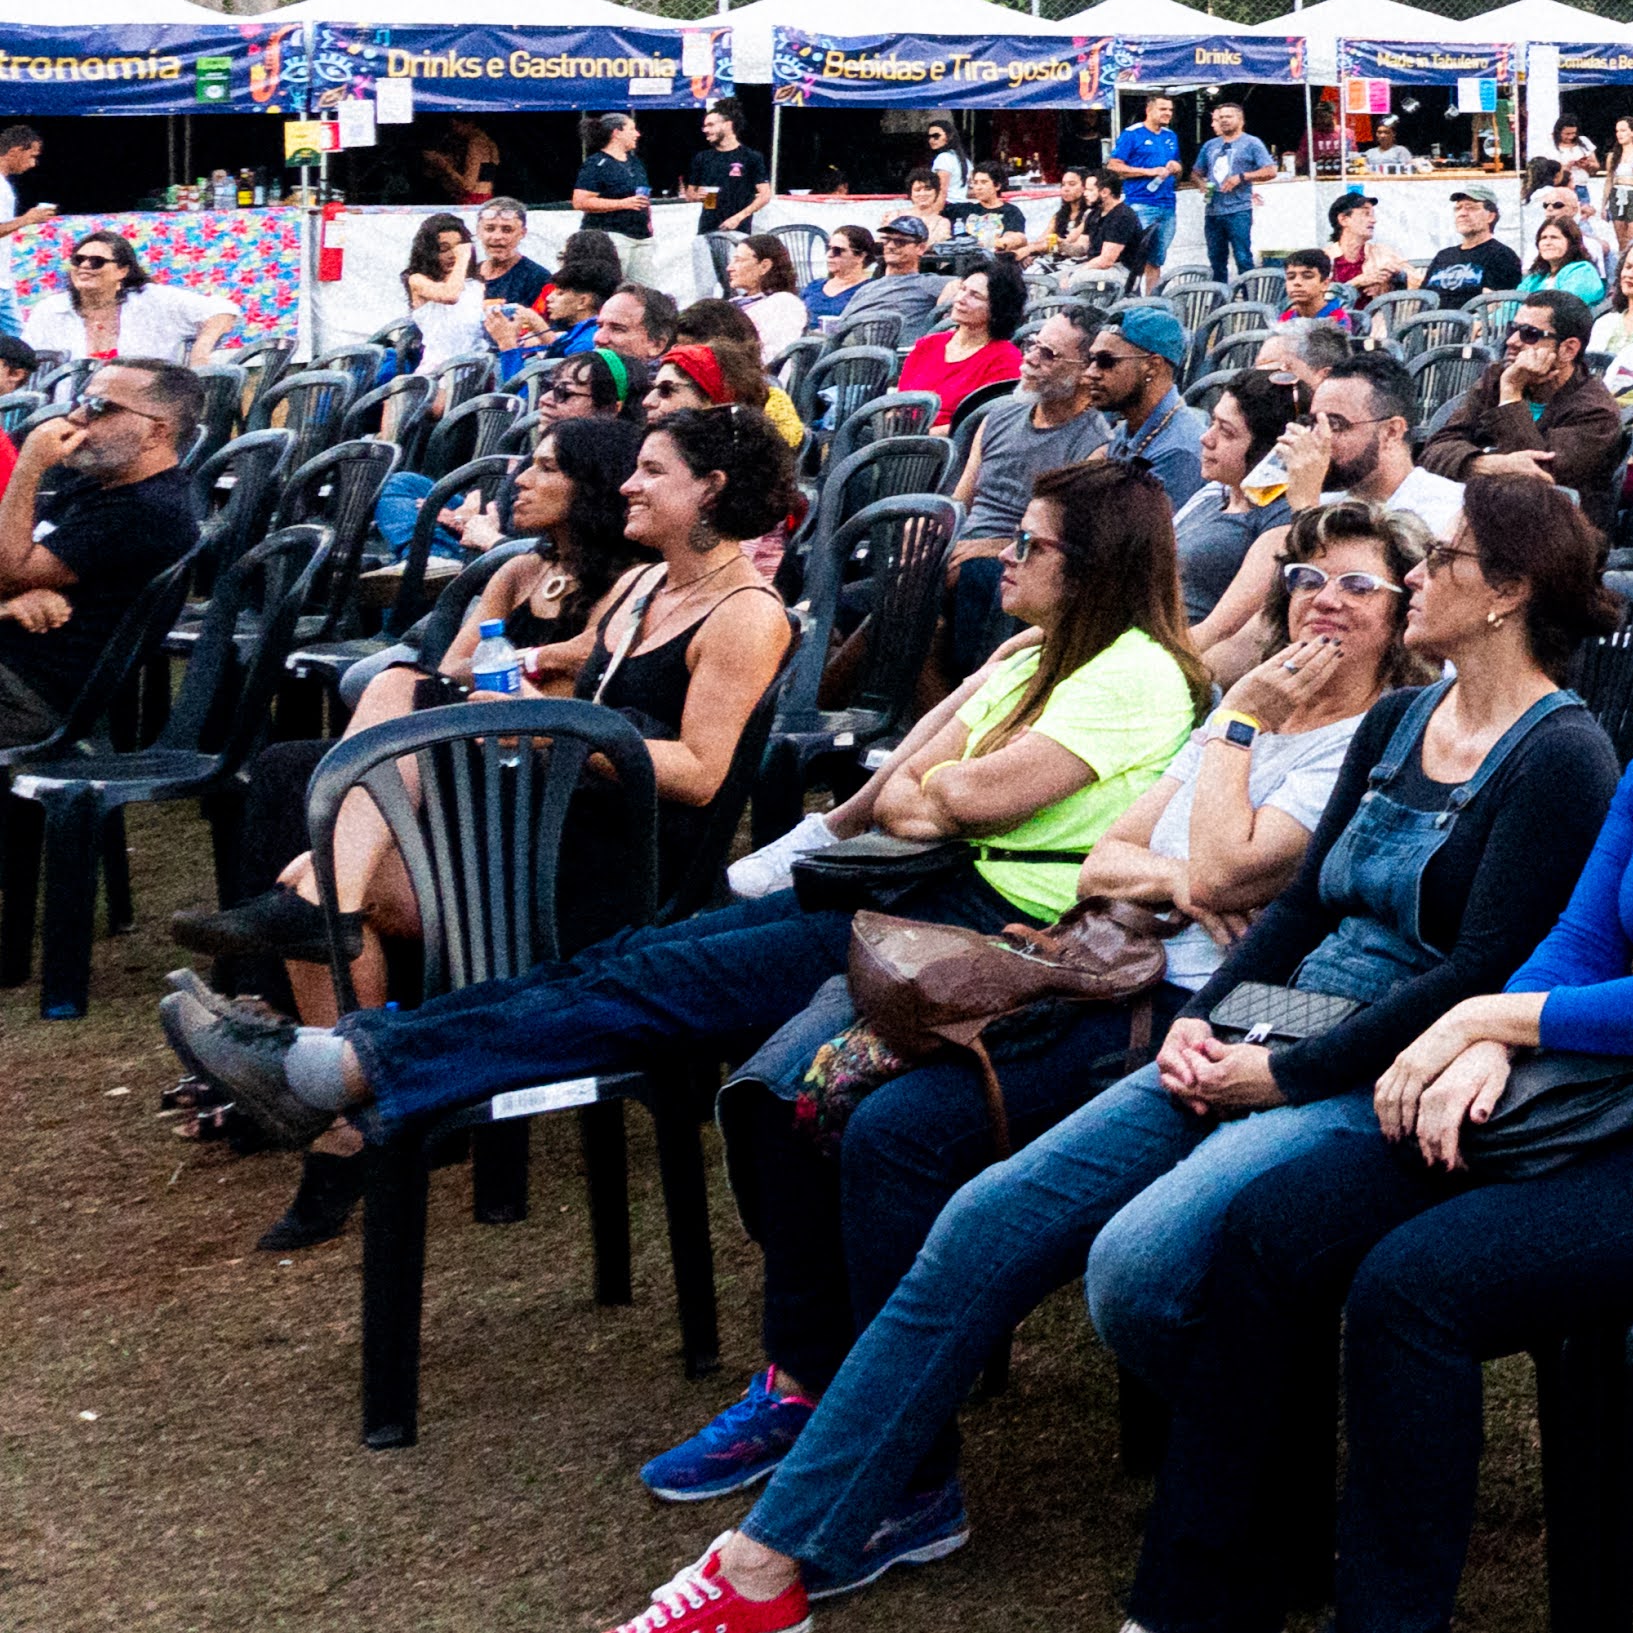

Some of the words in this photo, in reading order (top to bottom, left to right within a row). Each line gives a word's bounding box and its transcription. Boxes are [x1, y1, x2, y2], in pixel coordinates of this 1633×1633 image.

[388, 48, 481, 78] Drinks
[486, 56, 504, 78] e
[509, 50, 676, 78] Gastronomia
[1195, 48, 1242, 65] Drinks
[1376, 52, 1415, 68] Made
[1416, 53, 1429, 68] in
[1431, 53, 1489, 69] Tabuleiro
[1609, 59, 1617, 69] e
[822, 51, 926, 81] Bebidas
[930, 61, 946, 81] e
[949, 54, 1072, 88] Tira-gosto
